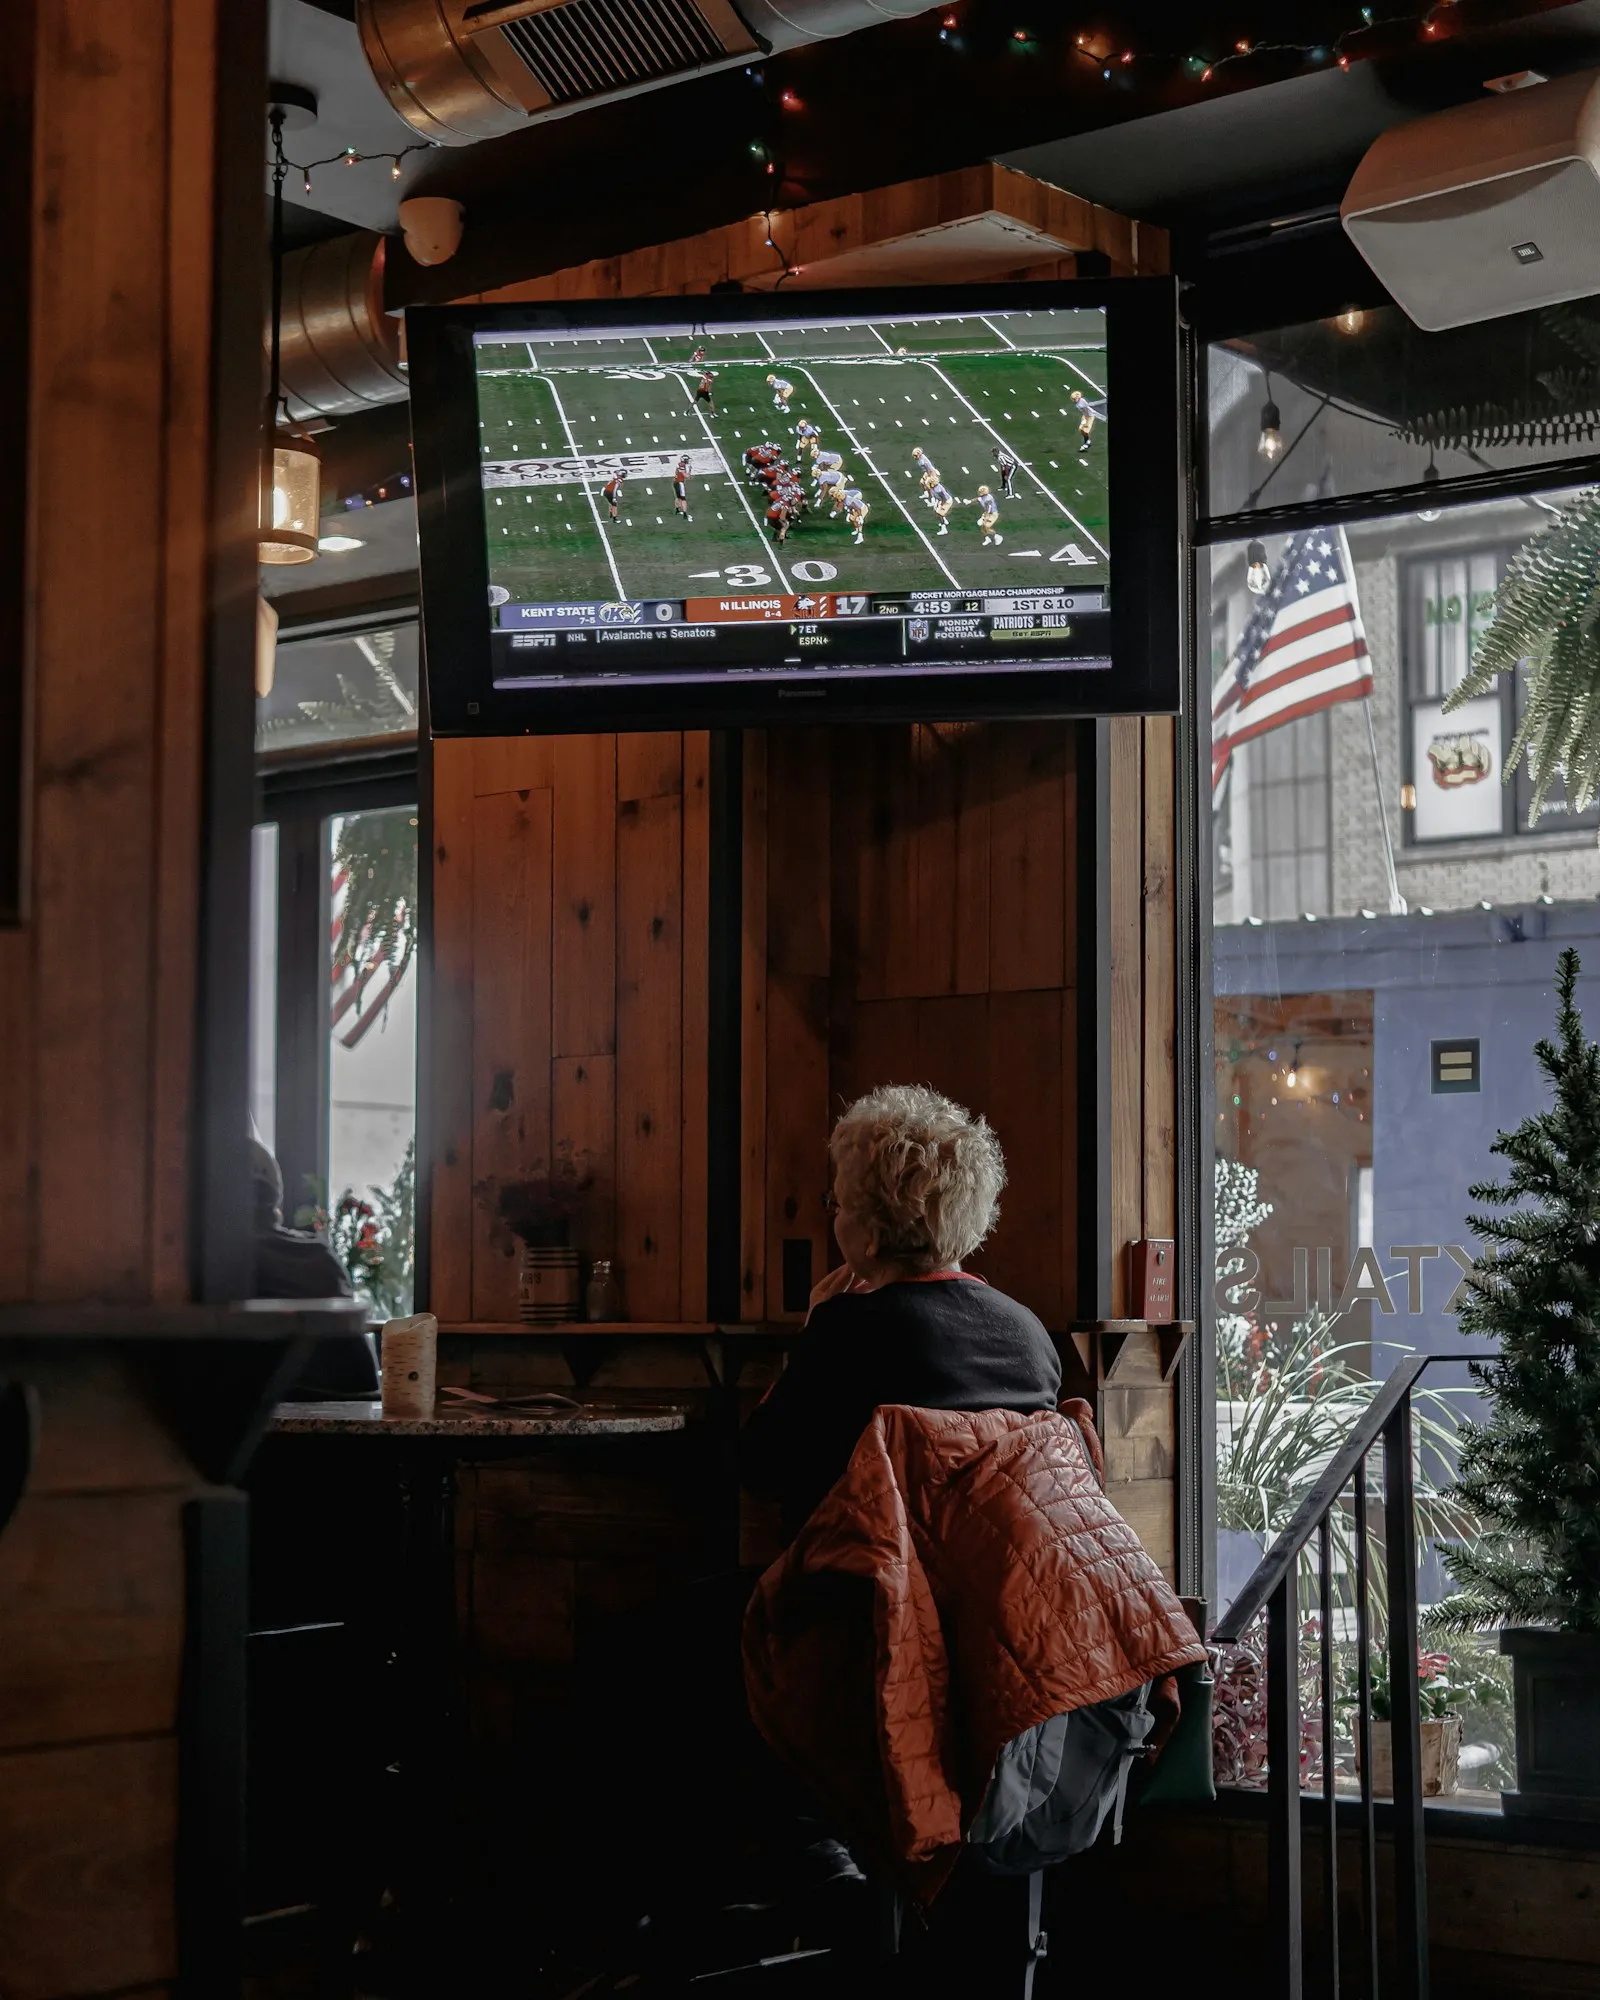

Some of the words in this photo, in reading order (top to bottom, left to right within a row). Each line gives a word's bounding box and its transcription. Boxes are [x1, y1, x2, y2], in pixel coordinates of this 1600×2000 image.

[1518, 248, 1535, 257] JBL
[481, 454, 677, 475] ROCKET
[520, 468, 643, 480] Mortgae
[911, 592, 943, 600] ROCKET
[944, 590, 988, 598] MORTGAGE
[989, 589, 1006, 597] MAC
[1006, 588, 1065, 596] CHAMPIONSHIP
[720, 602, 730, 610] N
[732, 600, 782, 610] ILLINOIS
[836, 596, 866, 615] 17
[880, 605, 899, 614] 2ND
[913, 601, 951, 614] 4:59
[965, 602, 979, 611] 12
[1012, 600, 1039, 610] 1ST
[1043, 599, 1053, 609] &
[1057, 598, 1074, 609] 10
[522, 608, 554, 618] KENT
[557, 606, 596, 616] STATE
[655, 603, 673, 621] 0
[993, 616, 1034, 629] PATRIOTS
[1042, 614, 1067, 628] BILLS
[602, 630, 653, 640] Avalanche
[670, 628, 716, 638] Senators
[807, 625, 818, 633] ET
[934, 630, 985, 639] FOOTBALL
[512, 633, 556, 647] ESPN
[567, 633, 587, 642] NHL
[1152, 1277, 1167, 1286] FIRE
